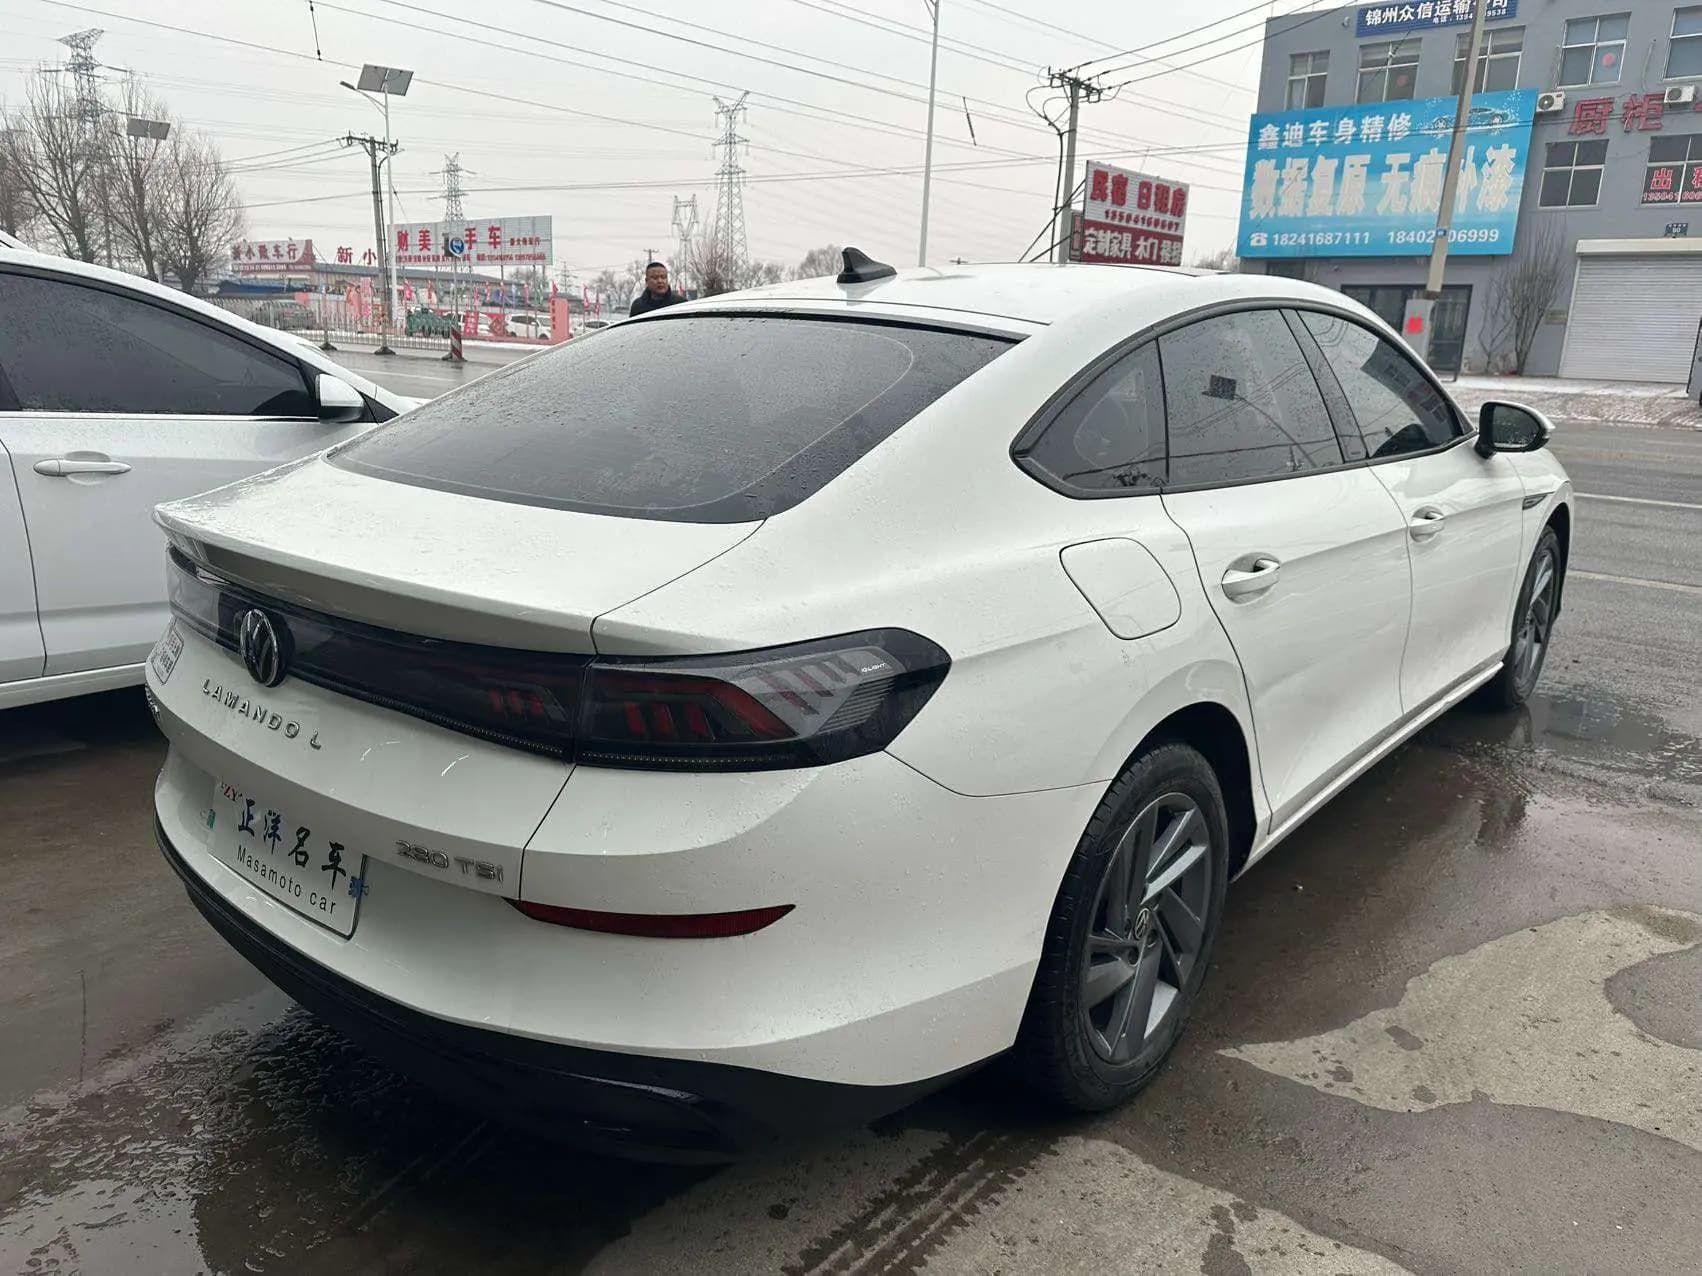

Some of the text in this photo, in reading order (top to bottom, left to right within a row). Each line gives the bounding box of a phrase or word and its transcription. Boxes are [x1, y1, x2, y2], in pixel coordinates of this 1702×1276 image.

[1366, 0, 1509, 26] 锦州众信运输司
[1257, 112, 1412, 151] 鑫迪车身精修
[1250, 153, 1372, 220] 数据复原
[396, 225, 503, 252] 财美手车
[1273, 228, 1500, 247] 18241687111 1840206999
[202, 678, 301, 740] LAMANDO
[309, 729, 322, 750] L
[236, 845, 337, 915] Masamoto car
[453, 856, 504, 882] TSI
